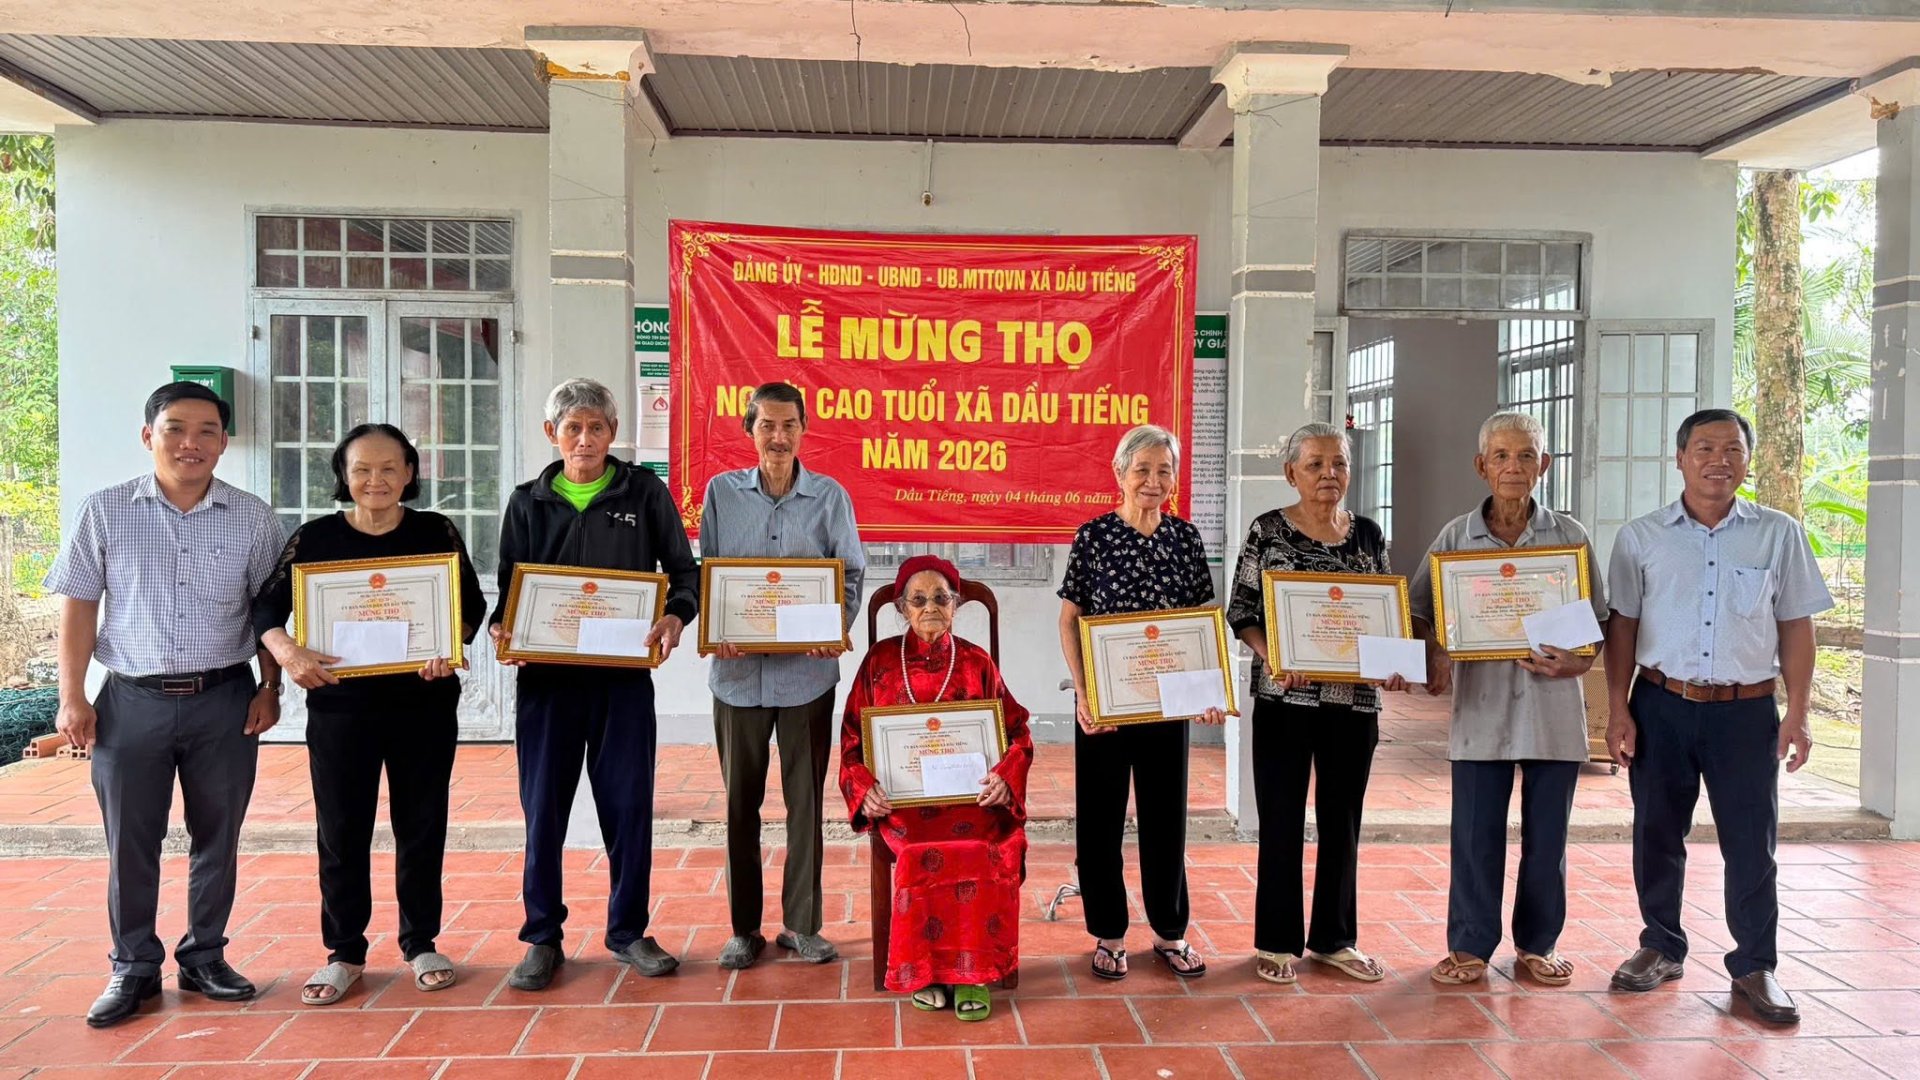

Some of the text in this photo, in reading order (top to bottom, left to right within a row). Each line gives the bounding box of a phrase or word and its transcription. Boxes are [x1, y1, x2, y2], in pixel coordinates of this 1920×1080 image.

[733, 255, 777, 283] ĐẢNG
[782, 256, 803, 284] ỦY
[818, 264, 862, 286] HĐND
[878, 265, 922, 288] UBND
[937, 267, 1026, 292] UB.MTTQVN
[1030, 266, 1051, 291] XÃ
[1055, 264, 1087, 292] DẦU
[1091, 265, 1137, 293] TIẾNG
[777, 299, 1093, 370] LỄ MỪNG THỌ
[1207, 338, 1227, 349] GIA
[816, 387, 872, 420] CAO
[882, 378, 945, 422] TUỔI
[954, 386, 993, 423] XÃ
[1002, 381, 1059, 424] DẦU
[1068, 384, 1149, 425] TIẾNG
[862, 432, 1007, 471] NĂM 2026
[895, 487, 924, 502] Dầu
[928, 488, 968, 505] Tiếng,
[971, 490, 1002, 506] ngày
[1005, 490, 1021, 503] 04
[1024, 490, 1061, 506] tháng
[1065, 491, 1081, 504] 06
[1084, 492, 1112, 504] năm
